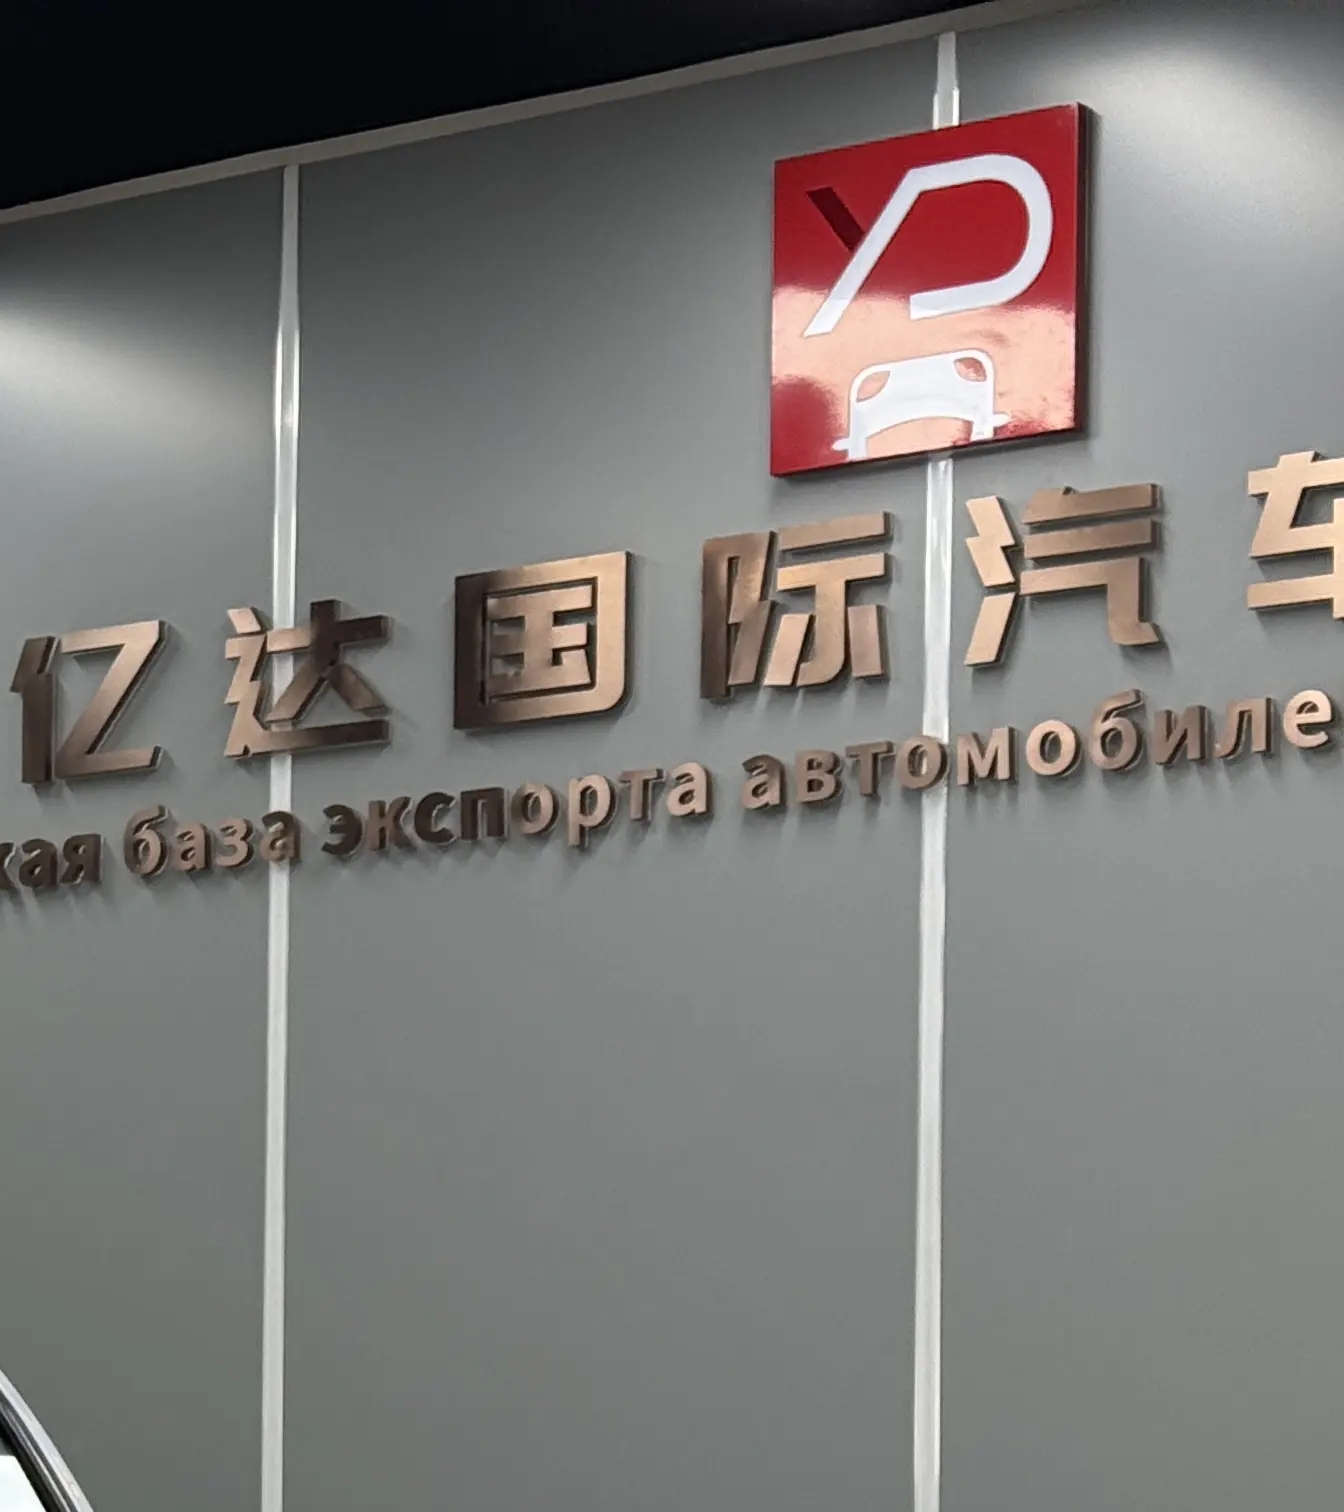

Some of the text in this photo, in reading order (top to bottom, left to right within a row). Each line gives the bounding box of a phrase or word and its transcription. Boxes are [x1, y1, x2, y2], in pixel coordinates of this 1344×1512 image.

[124, 805, 301, 876] база
[322, 761, 710, 858] экспорта
[741, 688, 1334, 809] автомобиле
